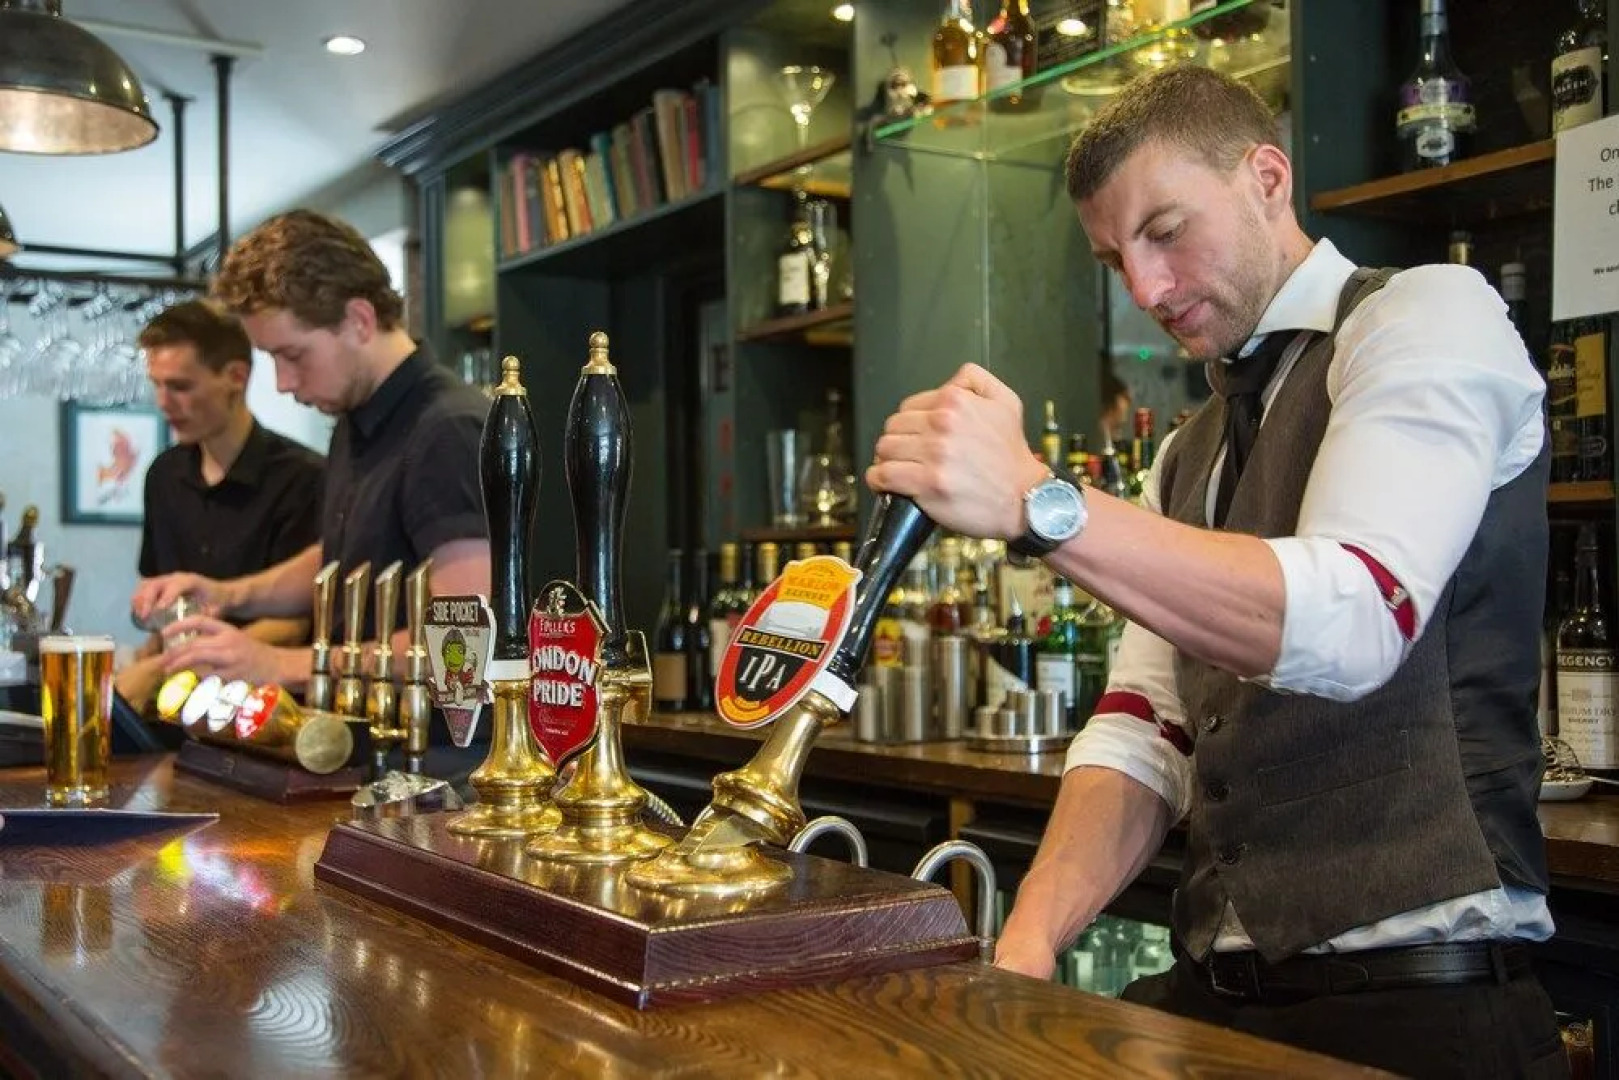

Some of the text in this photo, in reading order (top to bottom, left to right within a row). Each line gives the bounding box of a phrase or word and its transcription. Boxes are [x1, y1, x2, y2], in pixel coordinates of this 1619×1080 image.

[1588, 177, 1614, 192] The
[433, 601, 479, 622] SIDE POCKET
[742, 631, 820, 656] REBELLION
[531, 645, 596, 687] ONDON
[740, 654, 787, 691] IPA
[533, 679, 584, 707] PRIDE
